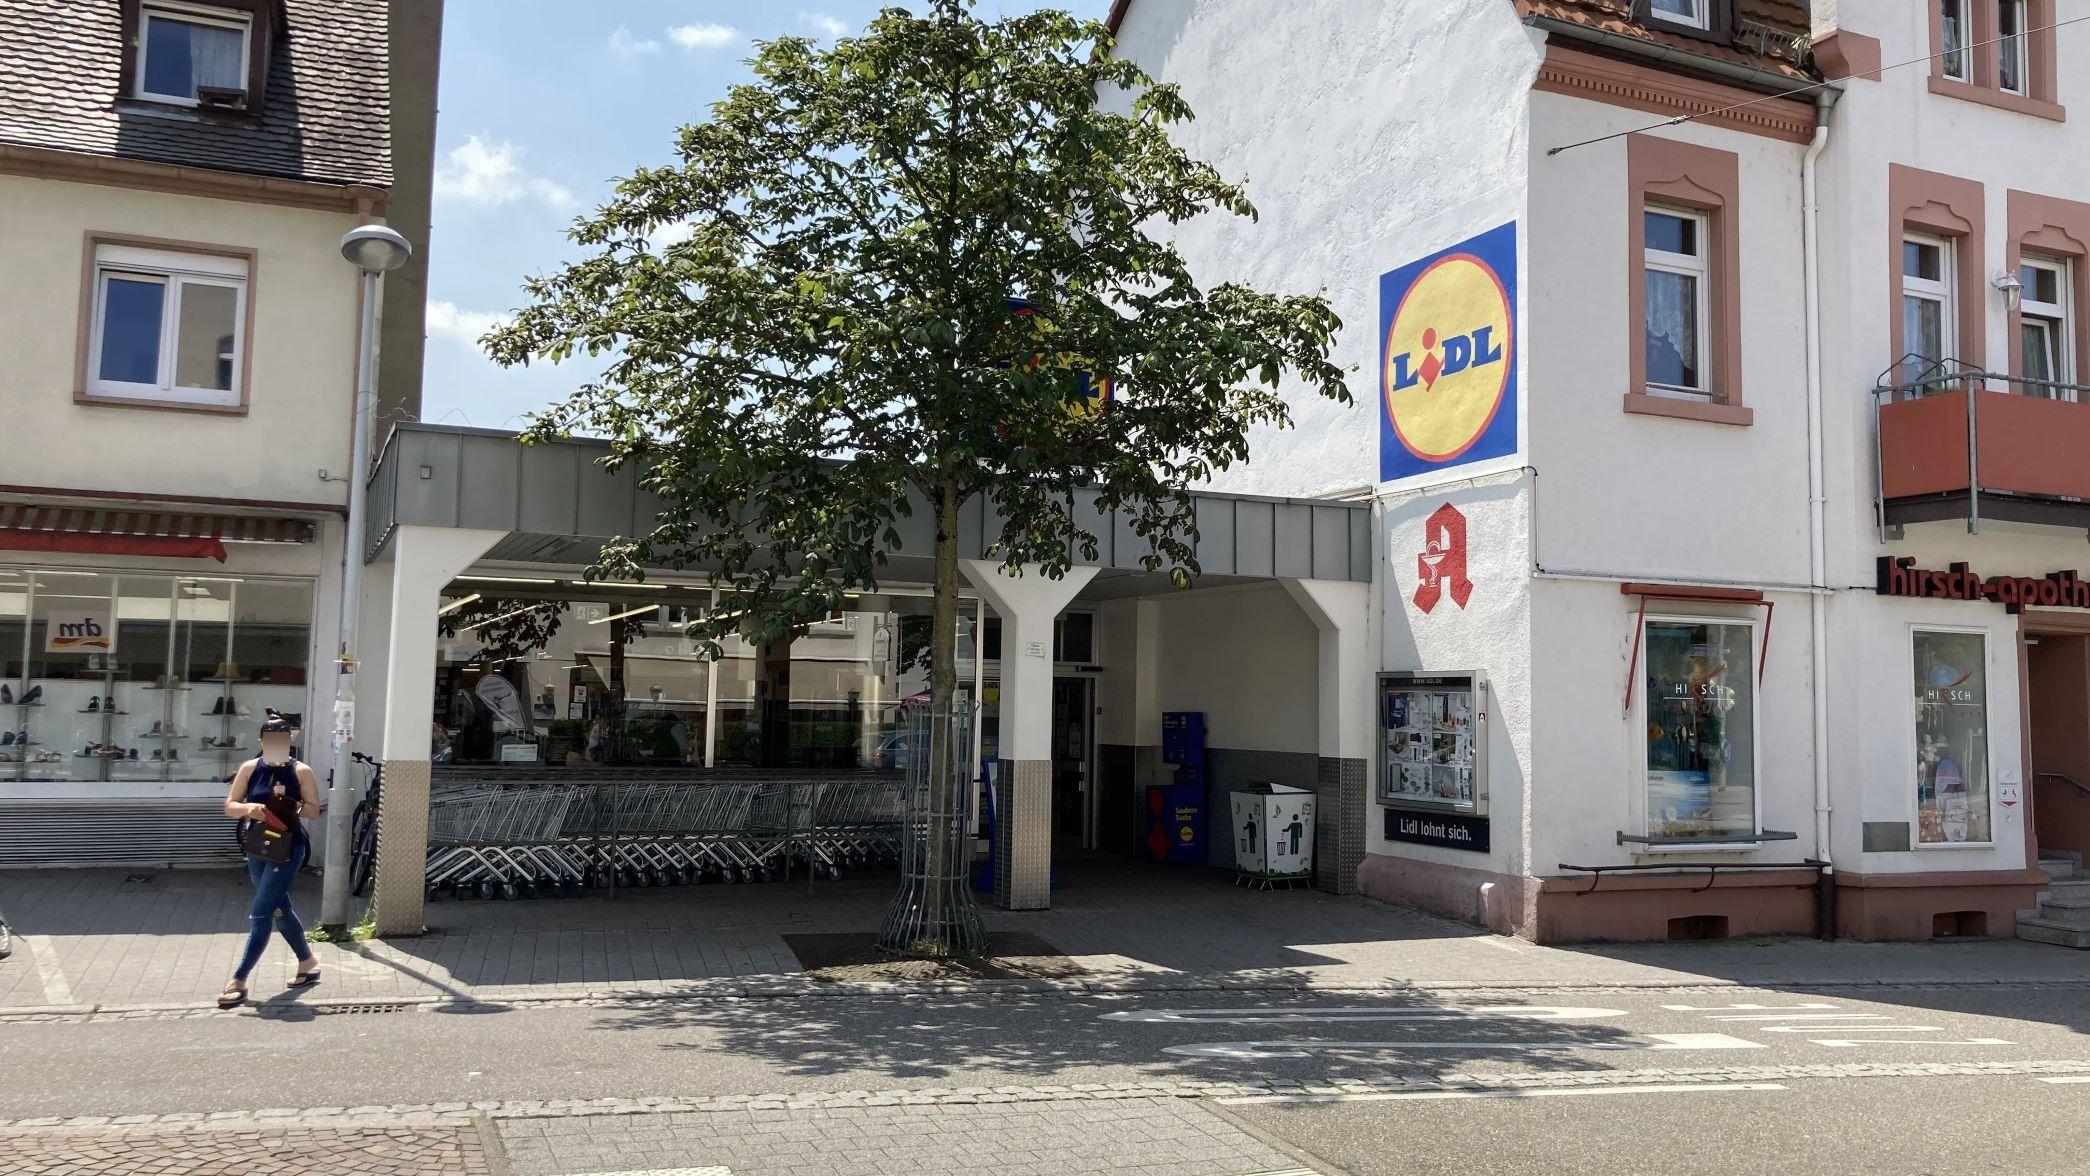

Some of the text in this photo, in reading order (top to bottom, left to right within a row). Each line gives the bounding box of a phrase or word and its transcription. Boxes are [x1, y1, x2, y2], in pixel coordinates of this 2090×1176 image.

[1400, 819, 1472, 842] Lidl lohnt sich.
